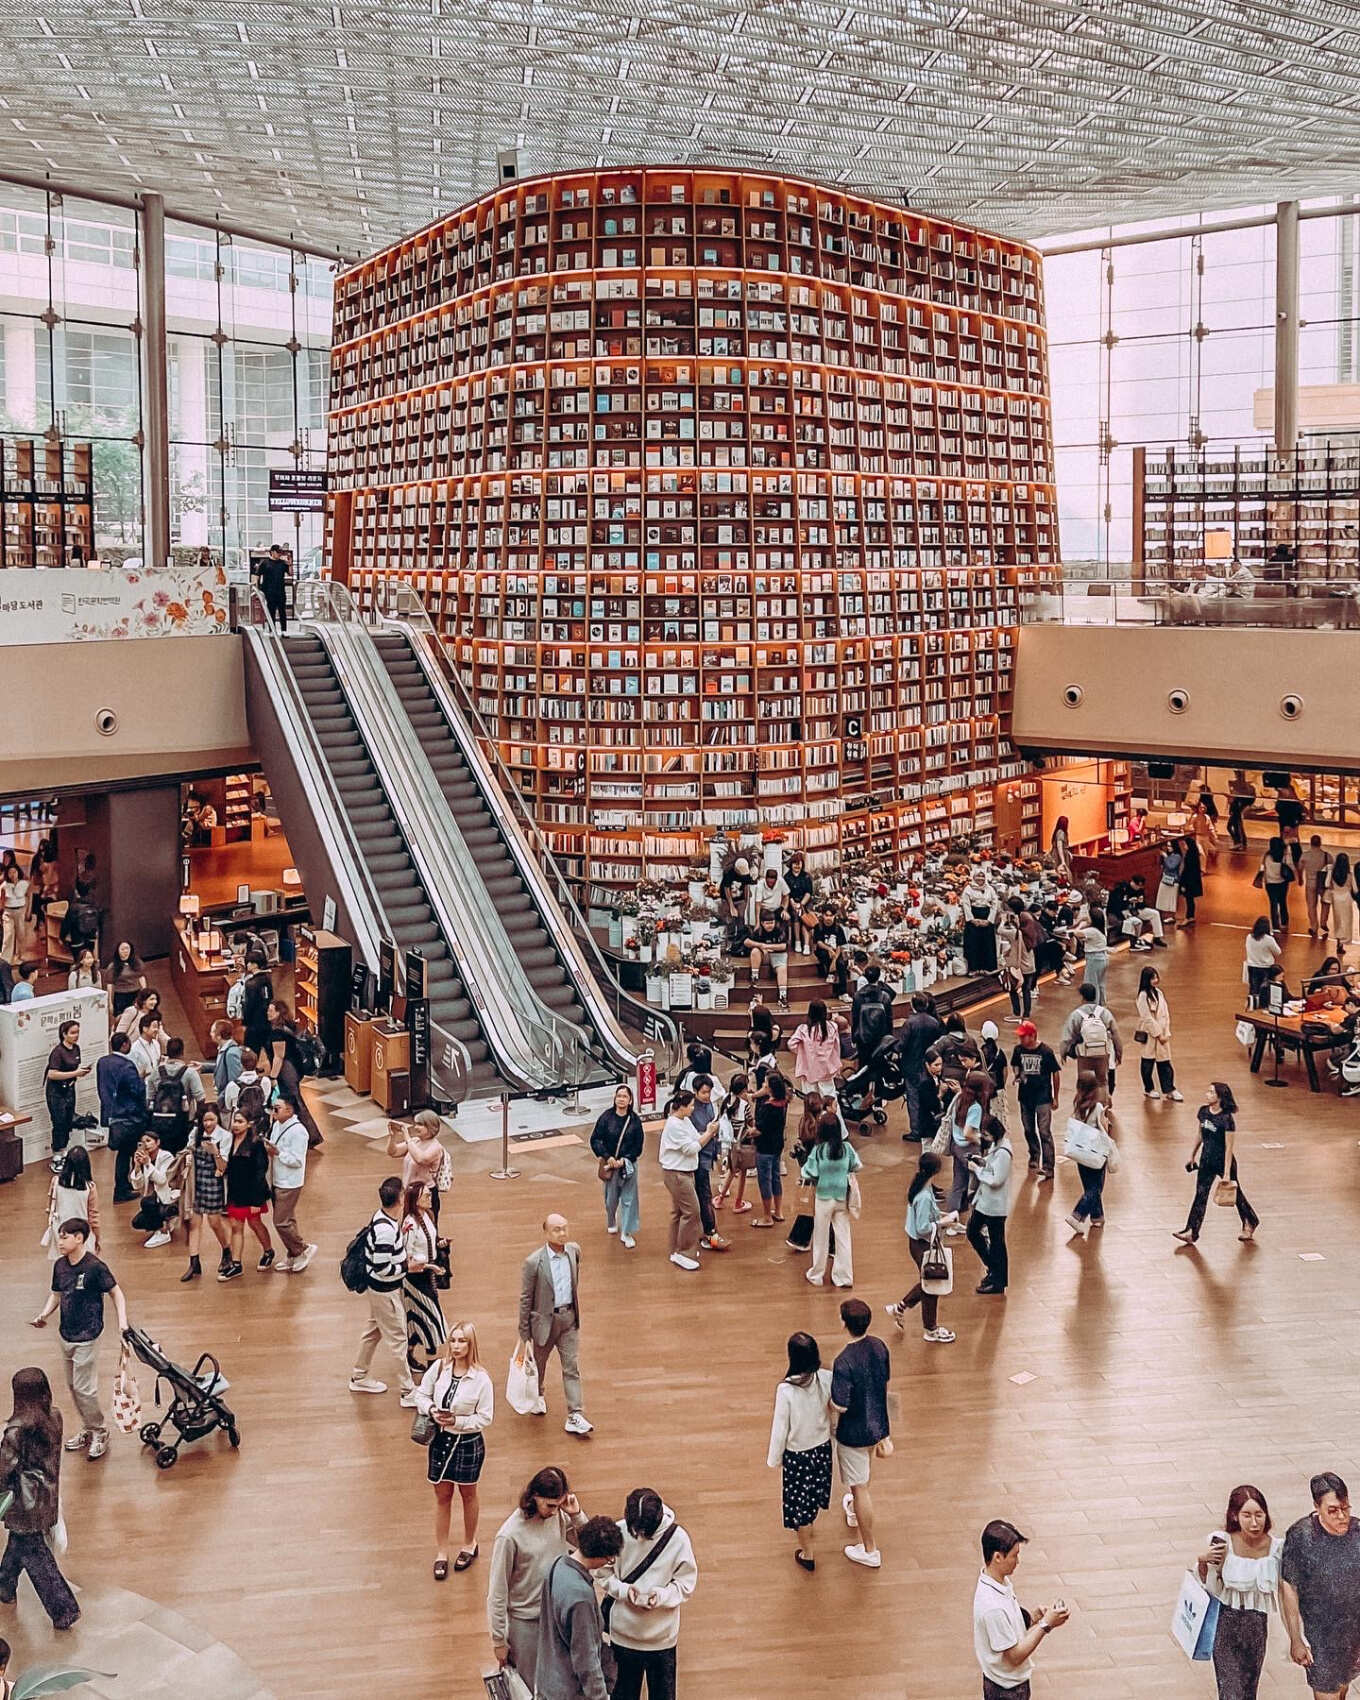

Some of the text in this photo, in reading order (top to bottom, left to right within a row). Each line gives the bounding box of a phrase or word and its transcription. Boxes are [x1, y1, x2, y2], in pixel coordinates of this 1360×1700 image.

[0, 596, 18, 612] 마당
[848, 720, 858, 736] C
[578, 753, 584, 770] C
